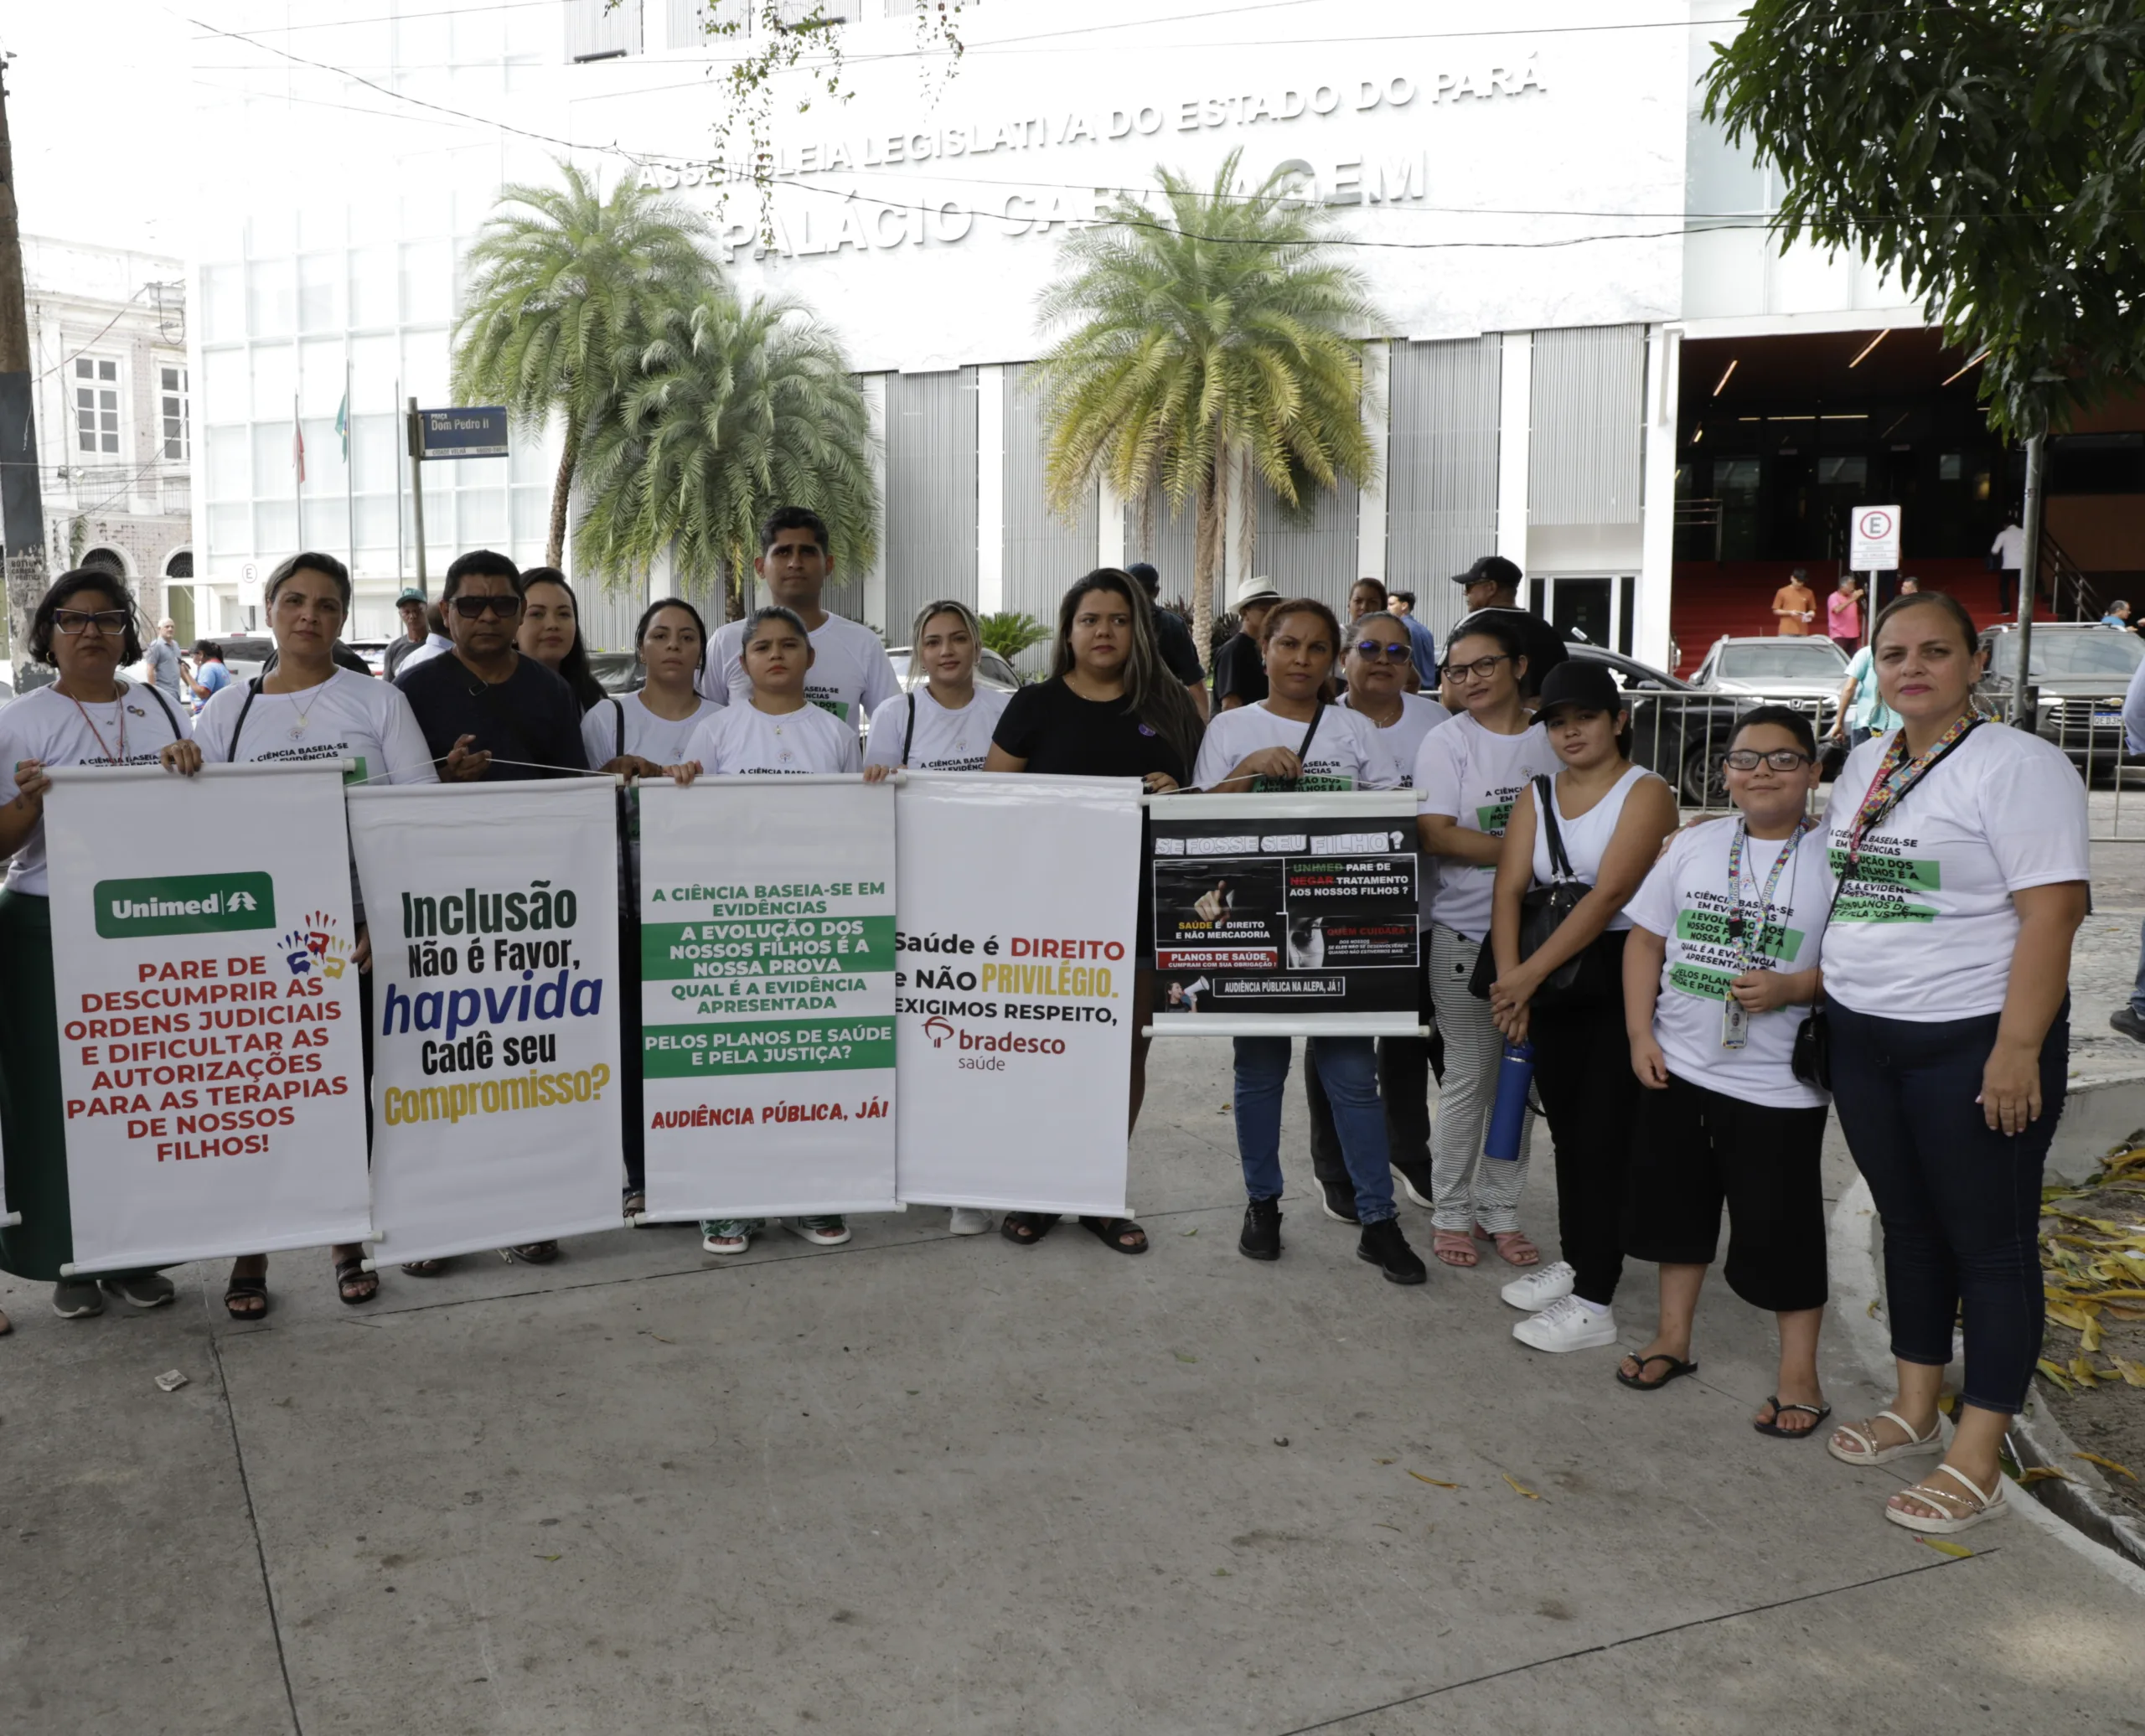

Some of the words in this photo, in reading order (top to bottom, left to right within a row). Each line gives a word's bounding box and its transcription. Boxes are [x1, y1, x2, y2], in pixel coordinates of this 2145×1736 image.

[864, 112, 1097, 168] LEGISLATIVA
[1108, 104, 1163, 140] DO
[1177, 85, 1341, 132] ESTADO
[1356, 75, 1417, 112] DO
[1432, 50, 1548, 104] PARÁ
[722, 189, 973, 264] PALÁCIO
[432, 420, 452, 431] Dom
[454, 419, 480, 430] Pedro
[483, 418, 489, 428] II
[1869, 516, 1881, 534] E
[246, 568, 253, 579] E
[804, 685, 840, 694] ASEIA-SE
[256, 749, 295, 762] CIÊNCIA
[297, 742, 349, 755] BASEIA-SE
[1494, 787, 1522, 795] CIÊNCI
[1155, 838, 1184, 855] SE
[1186, 836, 1259, 855] FOSSE
[1261, 834, 1306, 852] SEU
[1835, 840, 1848, 848] EM
[1868, 835, 1918, 848] BASEIA-SE
[1293, 864, 1343, 873] UNIMED
[1346, 863, 1373, 871] PARE
[1888, 859, 1914, 871] DOS
[652, 889, 666, 902] A
[671, 884, 749, 901] CIÊNCIA
[754, 882, 852, 898] BASEIA-SE
[858, 881, 885, 895] EM
[1290, 876, 1334, 886] NEGAR
[1336, 876, 1408, 885] TRATAMENTO
[1290, 888, 1311, 896] AOS
[1314, 887, 1357, 896] NOSSOS
[1361, 886, 1399, 895] FILHOS
[111, 893, 220, 919] Unimed
[712, 899, 827, 917] EVIDÊNCIAS
[1694, 891, 1729, 905] CIÊNCI
[1698, 902, 1710, 910] EM
[401, 880, 577, 938] Inclusão
[680, 926, 696, 941] A
[702, 919, 815, 942] EVOLUÇÃO
[821, 920, 864, 936] DOS
[1178, 920, 1212, 929] SAÚDE
[1184, 931, 1205, 939] NÃO
[1687, 922, 1722, 934] NOSSOS
[670, 943, 753, 960] NOSSOS
[759, 939, 831, 957] FILHOS
[837, 936, 849, 953] É
[855, 938, 870, 953] A
[895, 932, 974, 955] Saúde
[983, 935, 1000, 956] é
[1010, 937, 1125, 961] DIREITO
[1681, 942, 1698, 953] QUAL
[1690, 932, 1721, 945] NOSSA
[408, 940, 457, 979] Não
[467, 937, 484, 974] é
[494, 938, 580, 972] Favor,
[1171, 953, 1212, 961] PLANOS
[1232, 951, 1269, 962] SAÚDE,
[138, 959, 218, 983] PARE
[227, 956, 266, 976] DE
[693, 960, 764, 978] NOSSA
[769, 958, 841, 974] PROVA
[916, 965, 977, 991] NÃO
[981, 959, 1119, 998] PRIVILÉGIO.
[81, 980, 277, 1013] DESCUMPRIR
[286, 976, 323, 998] AS
[671, 984, 724, 1000] QUAL
[729, 979, 741, 996] É
[746, 982, 760, 995] A
[765, 977, 867, 995] EVIDÊNCIA
[1224, 979, 1260, 993] AUDIÊNCIA
[1262, 979, 1290, 992] PÚBLICA
[1292, 981, 1301, 991] NA
[1303, 981, 1326, 994] ALEPA,
[1698, 983, 1725, 996] PELA
[382, 969, 603, 1041] hapvida
[697, 995, 838, 1015] APRESENTADA
[895, 998, 997, 1018] EXIGIMOS
[1004, 1003, 1117, 1026] RESPEITO,
[64, 1012, 190, 1041] ORDENS
[199, 1000, 342, 1031] JUDICIAIS
[81, 1046, 99, 1066] E
[109, 1031, 282, 1064] DIFICULTAR
[292, 1027, 328, 1048] AS
[644, 1034, 708, 1051] PELOS
[713, 1031, 791, 1047] PLANOS
[796, 1030, 822, 1044] DE
[827, 1024, 892, 1042] SAÚDE
[959, 1029, 1066, 1055] bradesco
[421, 1031, 494, 1075] Cadê
[503, 1032, 556, 1067] seu
[691, 1051, 703, 1066] E
[709, 1050, 758, 1065] PELA
[762, 1045, 852, 1064] JUSTIÇA?
[91, 1051, 322, 1090] AUTORIZAÇÕES
[958, 1056, 1005, 1072] saúde
[67, 1093, 151, 1119] PARA
[160, 1089, 199, 1111] AS
[206, 1076, 348, 1106] TERAPIAS
[384, 1062, 611, 1126] Compromisso?
[127, 1118, 167, 1139] DE
[177, 1106, 295, 1134] NOSSOS
[651, 1104, 754, 1129] AUDIÊNCIA
[762, 1101, 848, 1124] PÚBLICA,
[855, 1096, 889, 1119] JÁ!
[157, 1134, 269, 1162] FILHOS!
